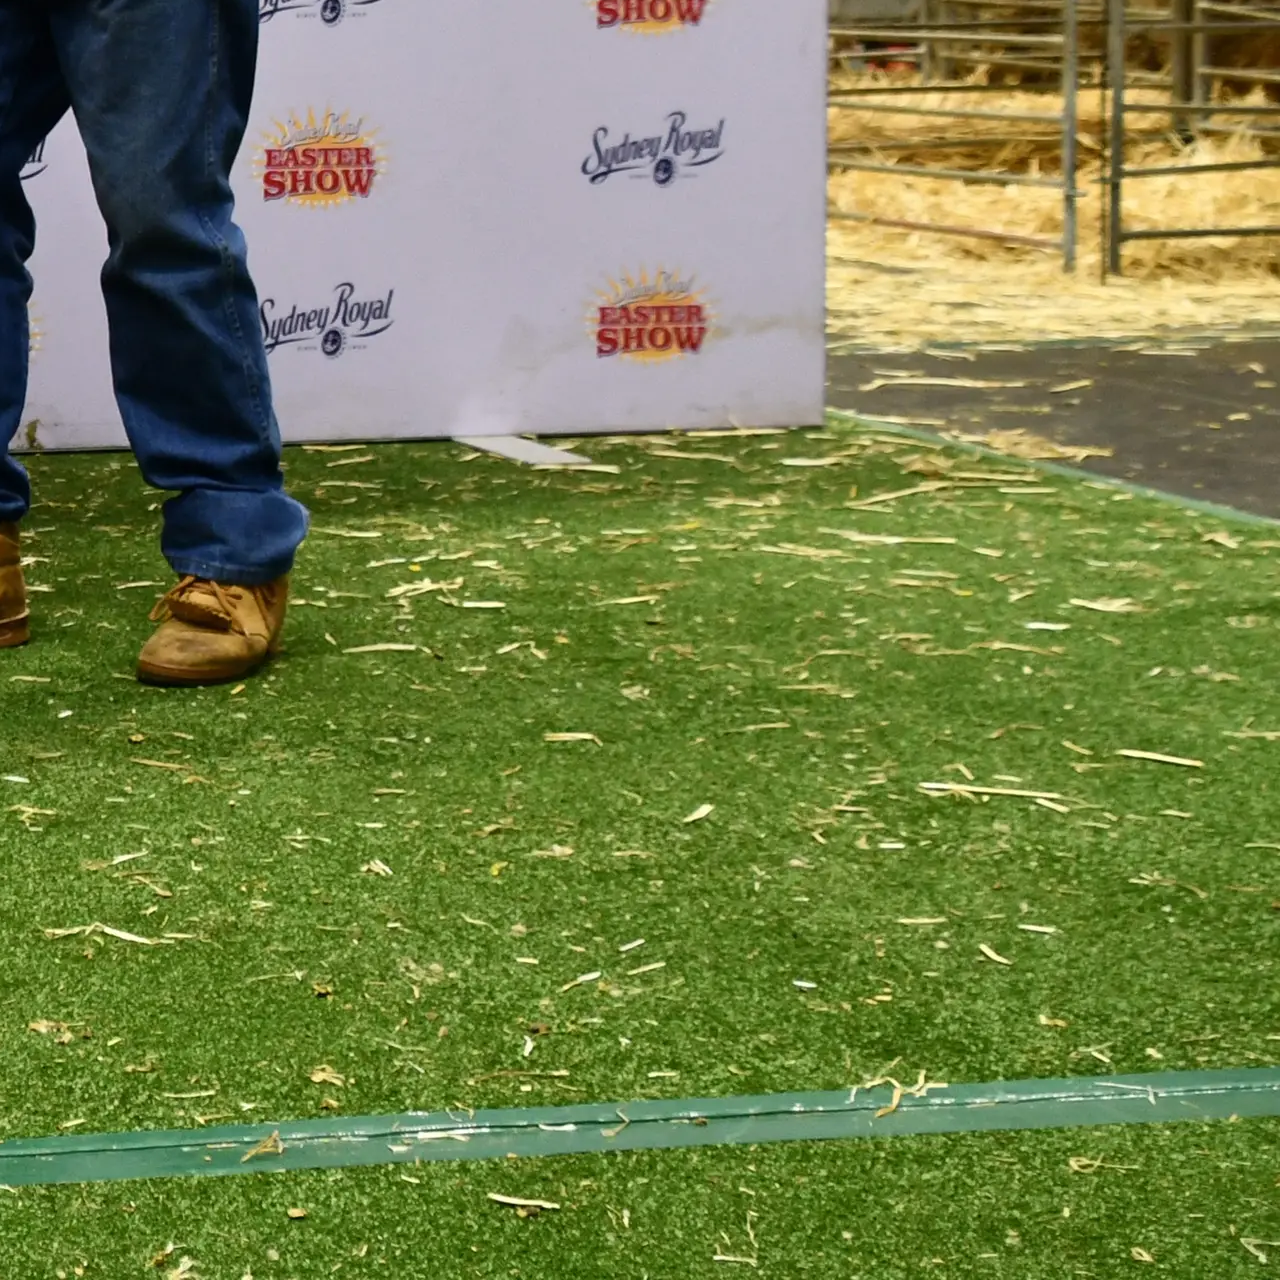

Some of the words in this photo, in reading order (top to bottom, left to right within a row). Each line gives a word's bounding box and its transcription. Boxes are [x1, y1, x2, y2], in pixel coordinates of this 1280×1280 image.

[263, 147, 375, 168] EASTER
[581, 126, 661, 184] Sydney
[664, 111, 725, 161] Royal
[262, 168, 375, 201] SHOW
[260, 299, 331, 355] Sydney
[330, 282, 394, 333] Royal
[598, 305, 706, 326] EASTER
[597, 326, 707, 357] SHOW
